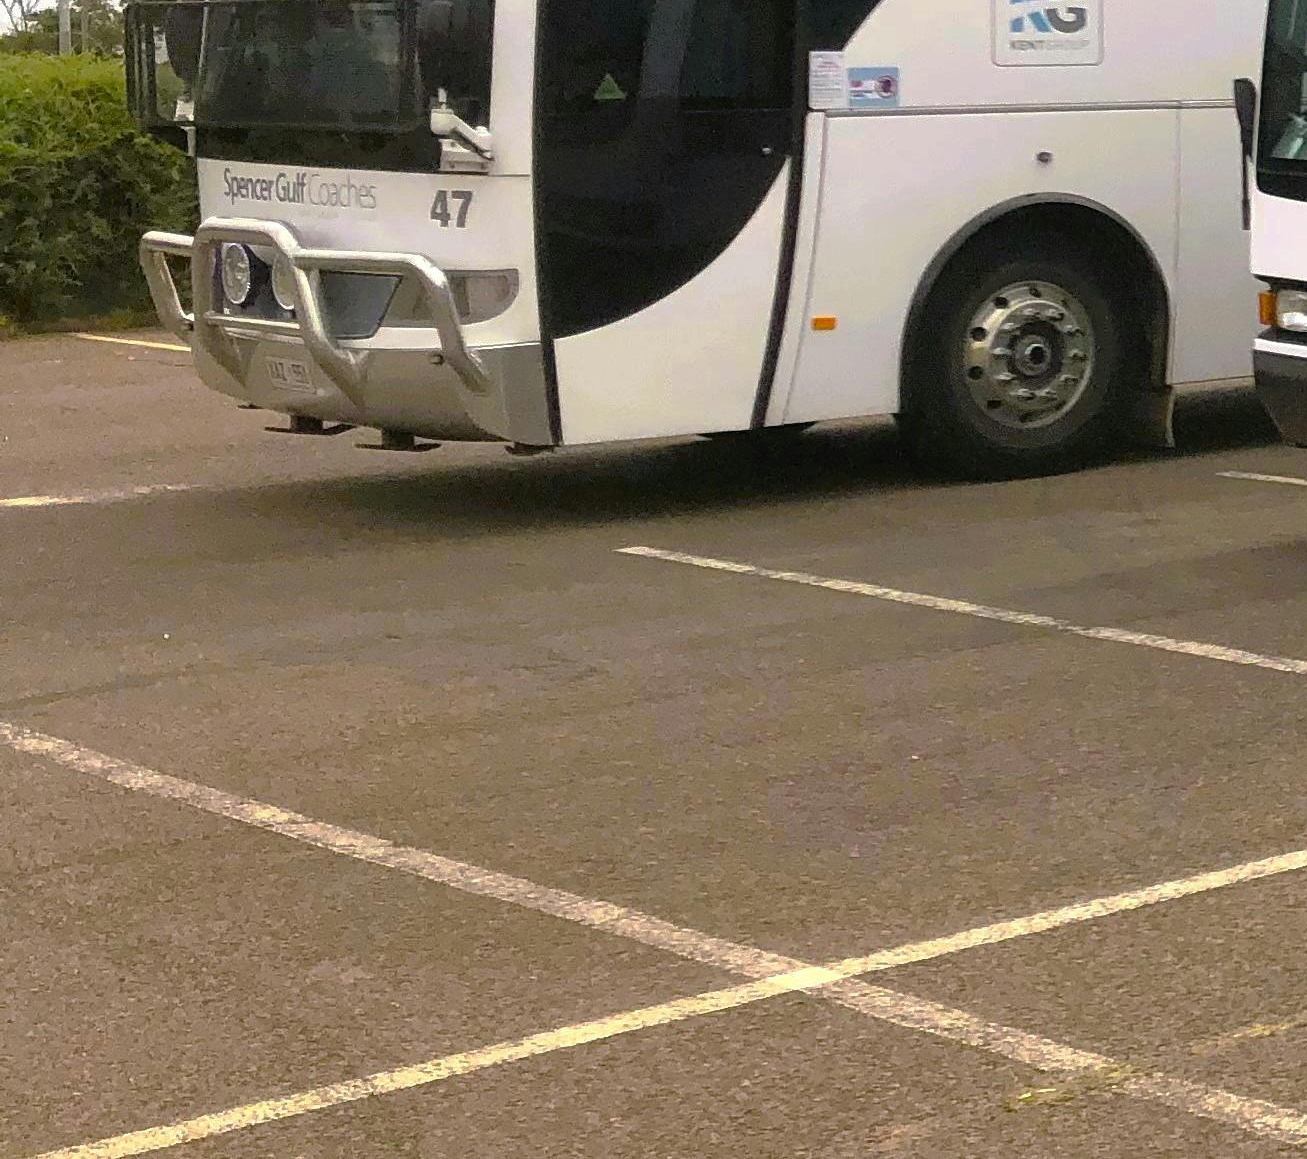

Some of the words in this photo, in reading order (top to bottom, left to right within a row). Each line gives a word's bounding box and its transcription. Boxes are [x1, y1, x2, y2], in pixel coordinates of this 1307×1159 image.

[223, 167, 273, 206] Spencer
[275, 172, 307, 205] Gulf
[308, 173, 377, 210] Coaches
[429, 189, 473, 229] 47
